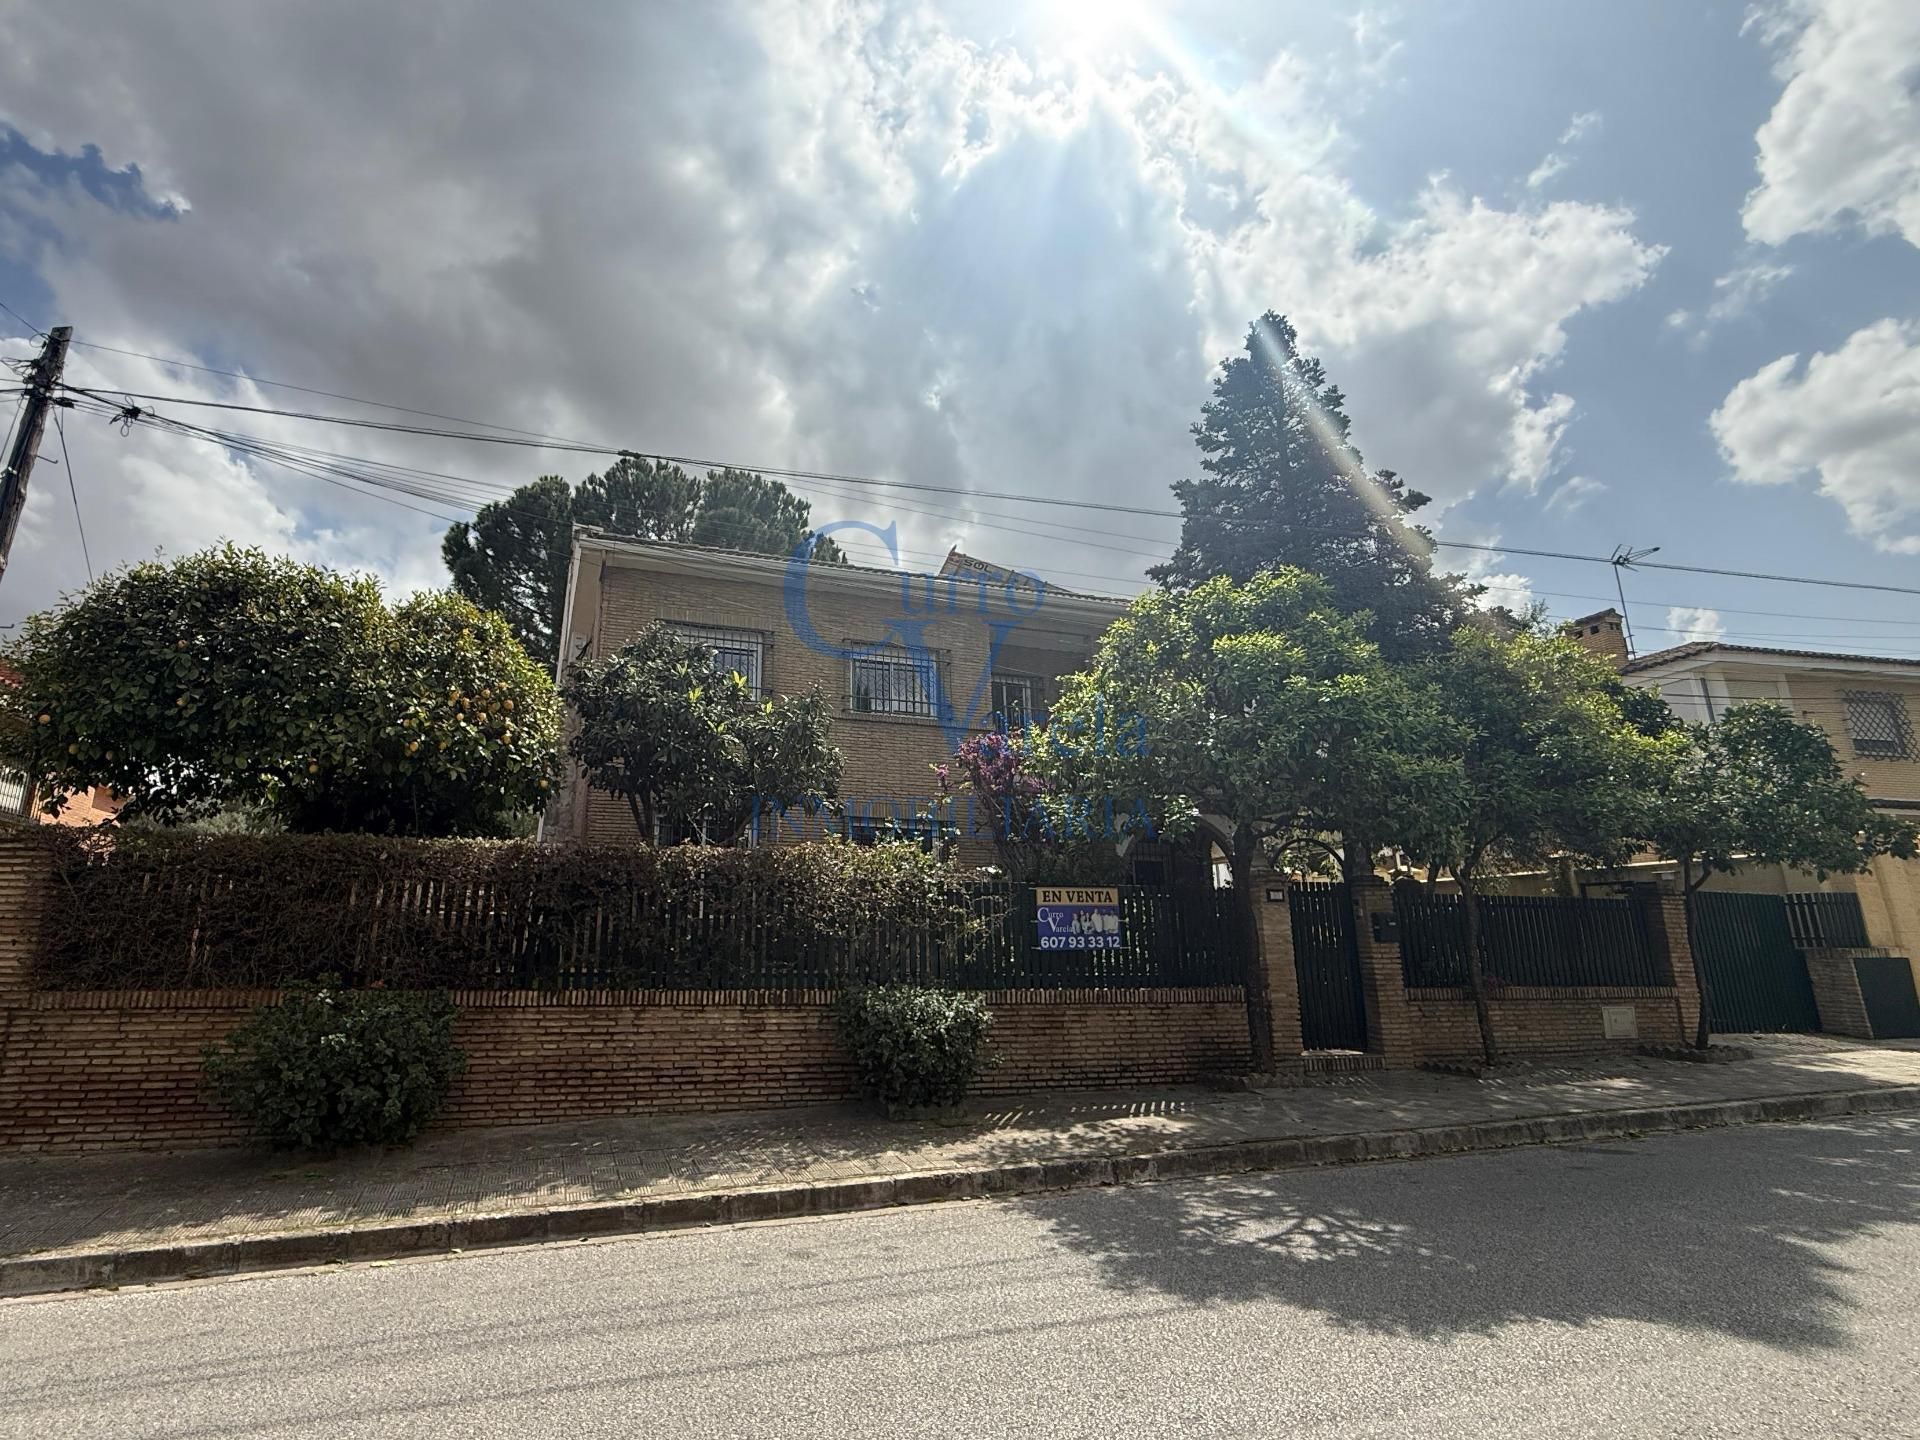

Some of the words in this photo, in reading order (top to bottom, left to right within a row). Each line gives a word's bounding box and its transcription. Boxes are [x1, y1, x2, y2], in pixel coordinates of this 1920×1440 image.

[1042, 890, 1062, 903] EN
[1065, 890, 1113, 903] VENTA
[1037, 907, 1064, 922] Curro
[1041, 936, 1066, 948] 607
[1068, 936, 1086, 948] 93
[1088, 936, 1104, 948] 33
[1106, 936, 1120, 948] 12
